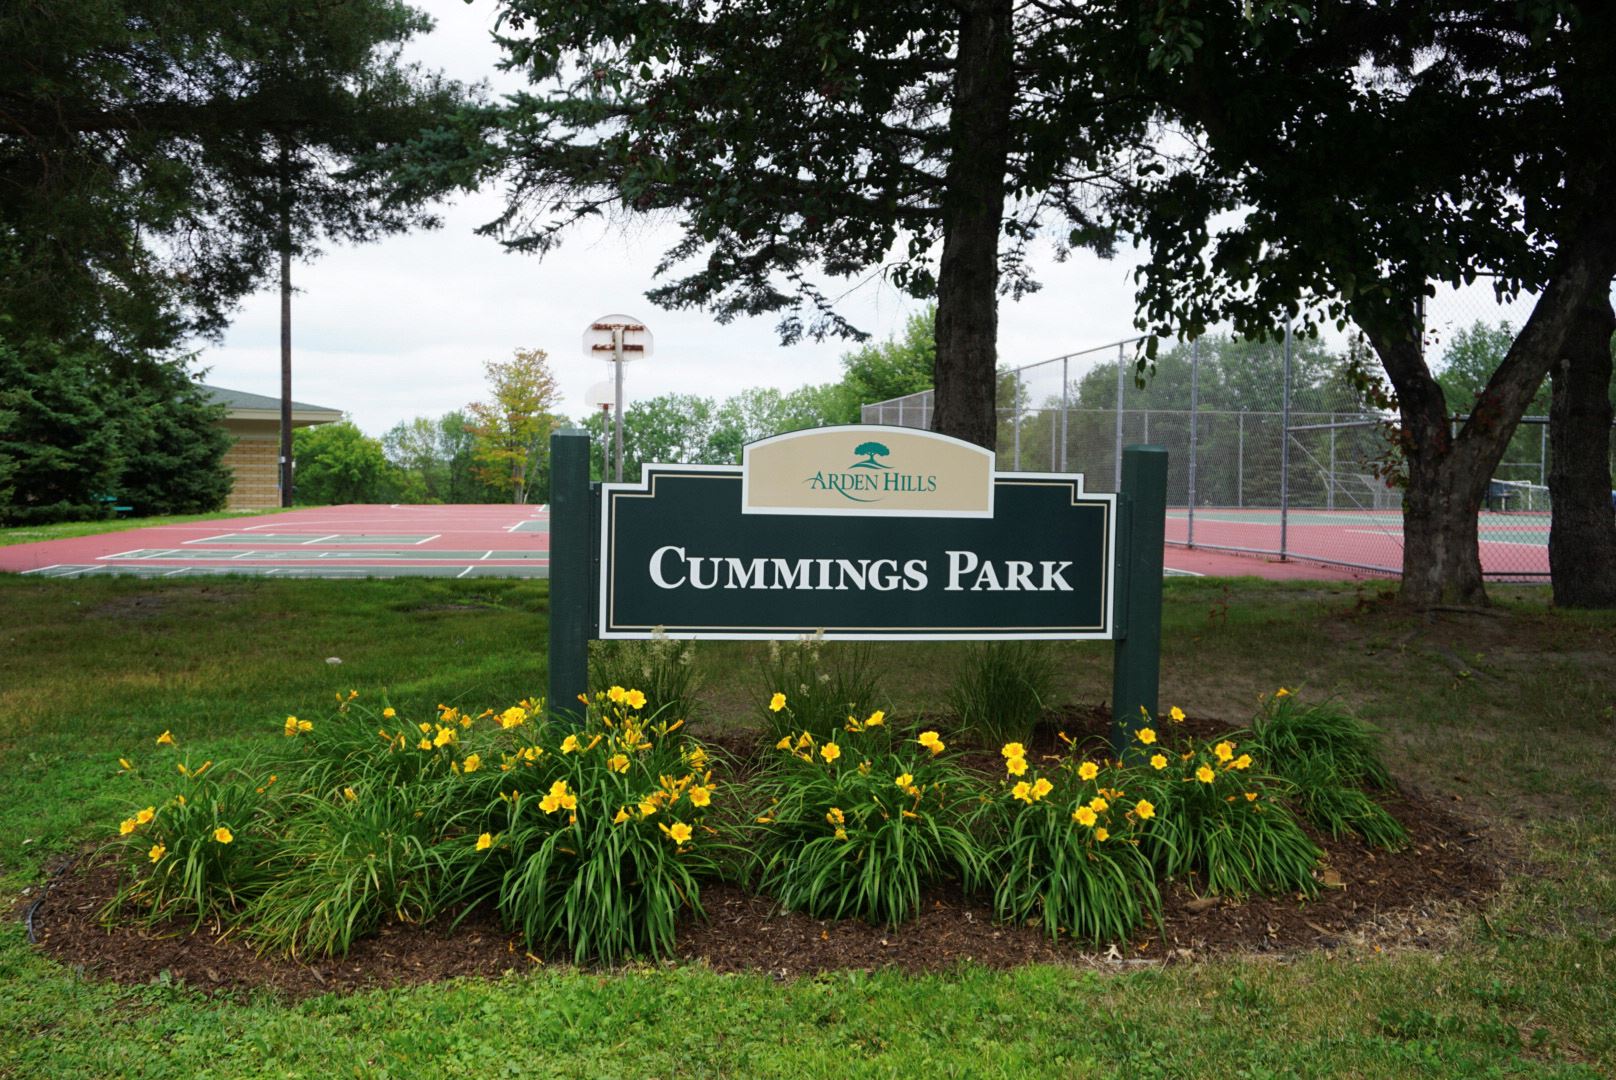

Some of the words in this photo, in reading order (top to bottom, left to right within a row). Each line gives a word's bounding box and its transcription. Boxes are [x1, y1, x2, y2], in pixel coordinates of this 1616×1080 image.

[807, 471, 879, 494] ARDEN
[883, 472, 937, 492] HILLS
[648, 545, 928, 591] CUMMINGS
[944, 550, 1074, 591] PARK
